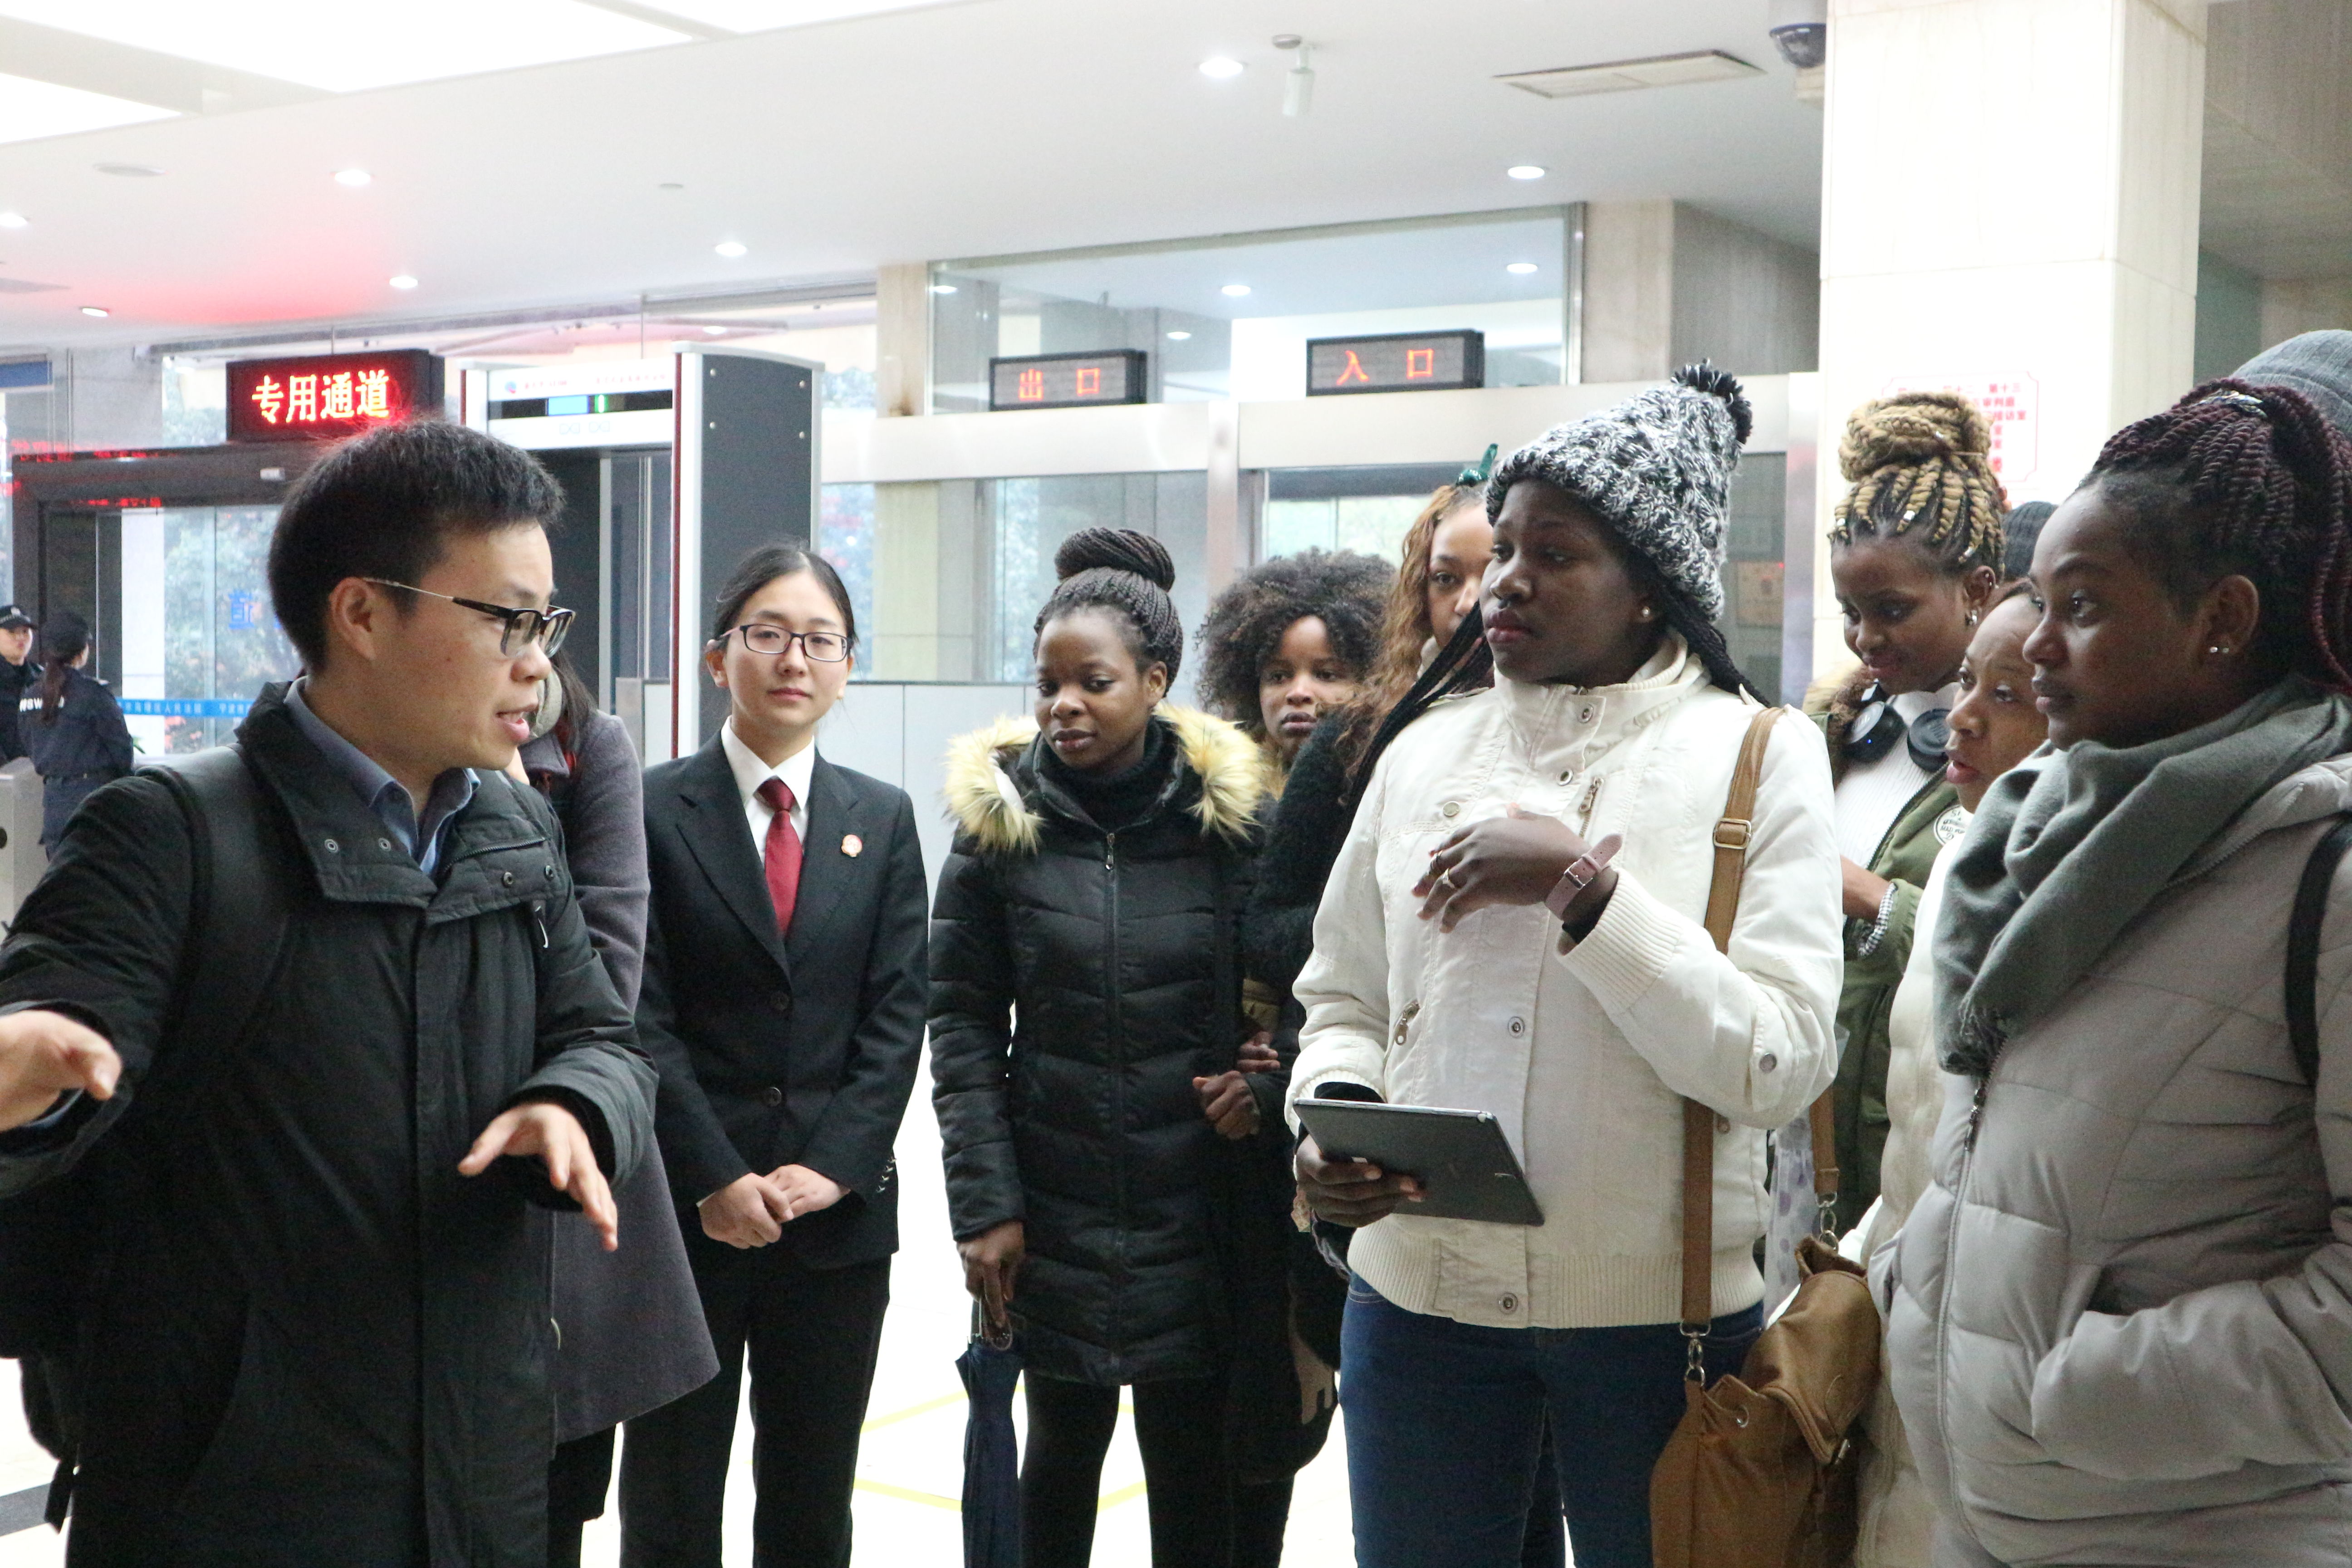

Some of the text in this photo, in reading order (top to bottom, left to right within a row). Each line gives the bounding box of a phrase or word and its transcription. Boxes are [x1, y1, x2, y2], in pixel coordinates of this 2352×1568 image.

[1018, 368, 1101, 401] 出口
[1336, 348, 1434, 386] 入口
[251, 369, 390, 424] 专用通道
